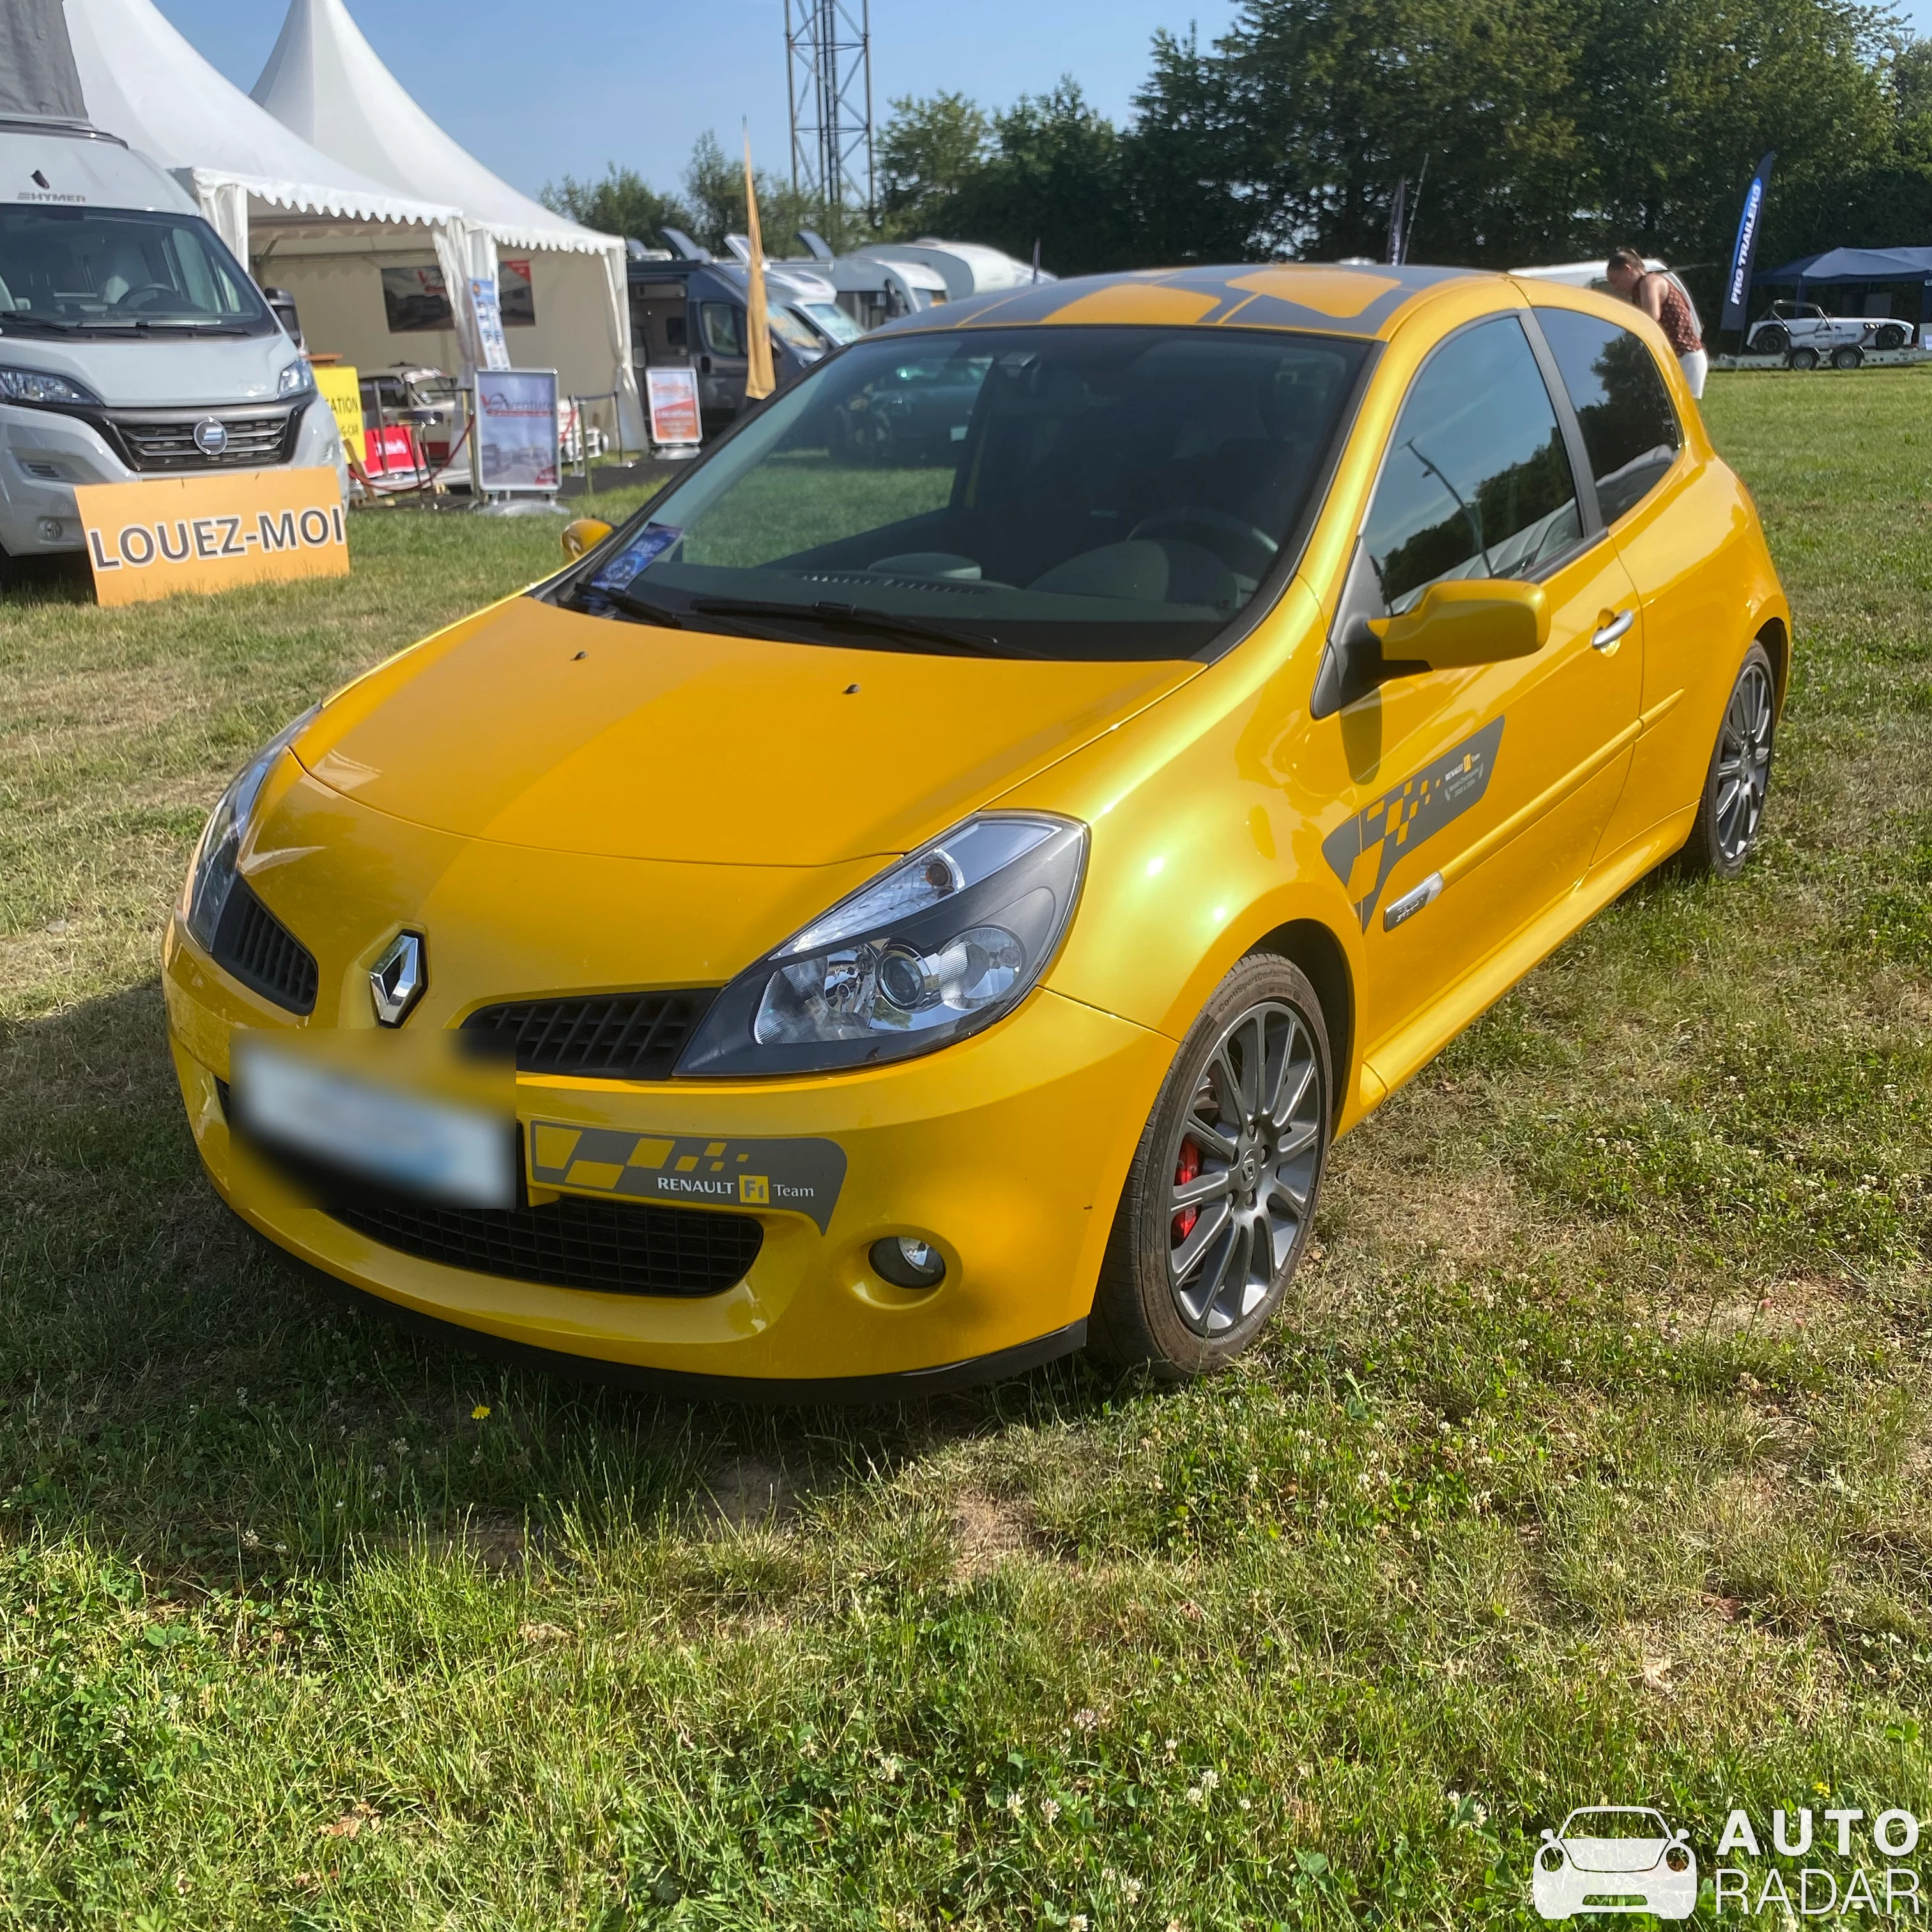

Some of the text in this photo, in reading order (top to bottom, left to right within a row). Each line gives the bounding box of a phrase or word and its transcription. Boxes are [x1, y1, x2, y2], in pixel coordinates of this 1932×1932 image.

[1730, 268, 1744, 305] PRO
[326, 397, 358, 415] ATION
[89, 507, 344, 569] LOUEZ-MOI
[657, 1177, 815, 1199] RENAULT F1 Team
